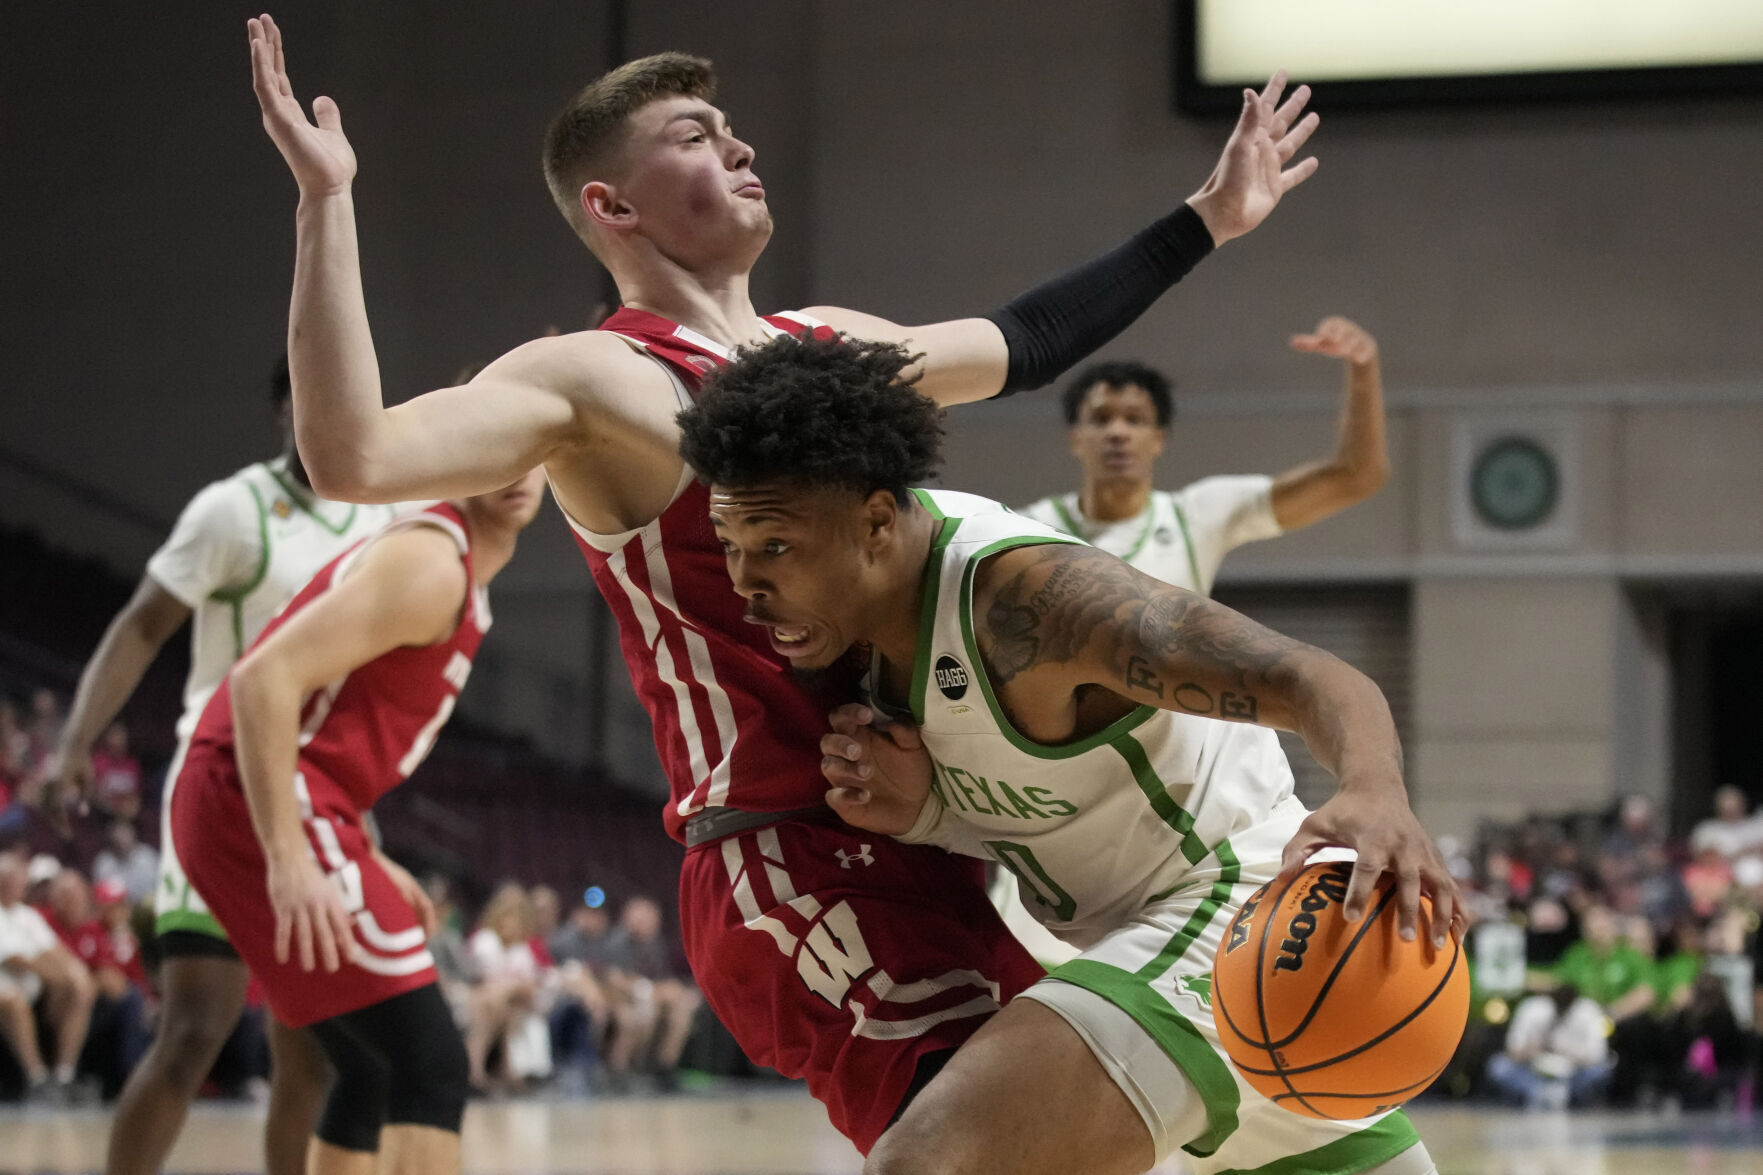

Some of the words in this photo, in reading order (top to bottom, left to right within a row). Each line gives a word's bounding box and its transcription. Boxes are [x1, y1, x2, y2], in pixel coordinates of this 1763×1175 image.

[935, 667, 968, 689] HAGG
[936, 759, 1079, 820] TEXAS
[797, 899, 875, 1011] W
